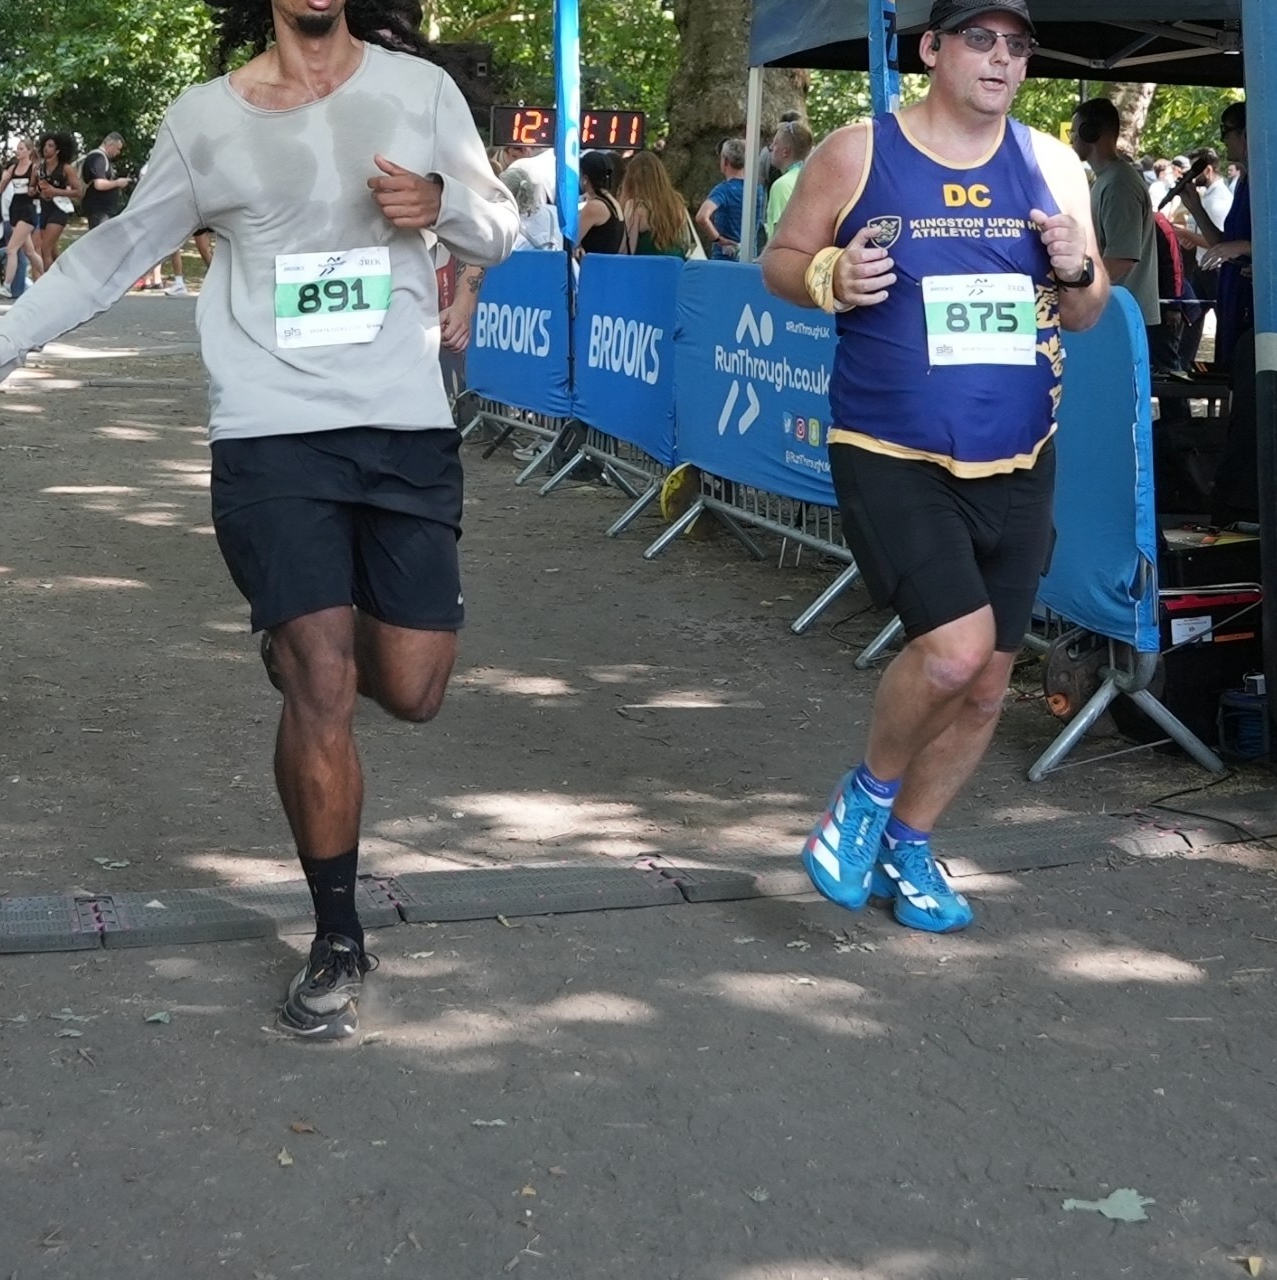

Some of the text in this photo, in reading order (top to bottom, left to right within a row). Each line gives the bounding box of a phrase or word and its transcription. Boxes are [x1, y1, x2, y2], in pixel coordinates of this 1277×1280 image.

[943, 183, 992, 208] DC
[909, 217, 984, 230] KINGSTON
[988, 217, 1025, 229] UPON
[911, 228, 1021, 239] ATHLETIC CLUB
[297, 277, 371, 314] 891
[476, 302, 552, 357] BROOKS
[946, 302, 1019, 333] 875
[588, 314, 664, 385] BROOKS
[715, 344, 831, 395] RunThrough.co.uk
